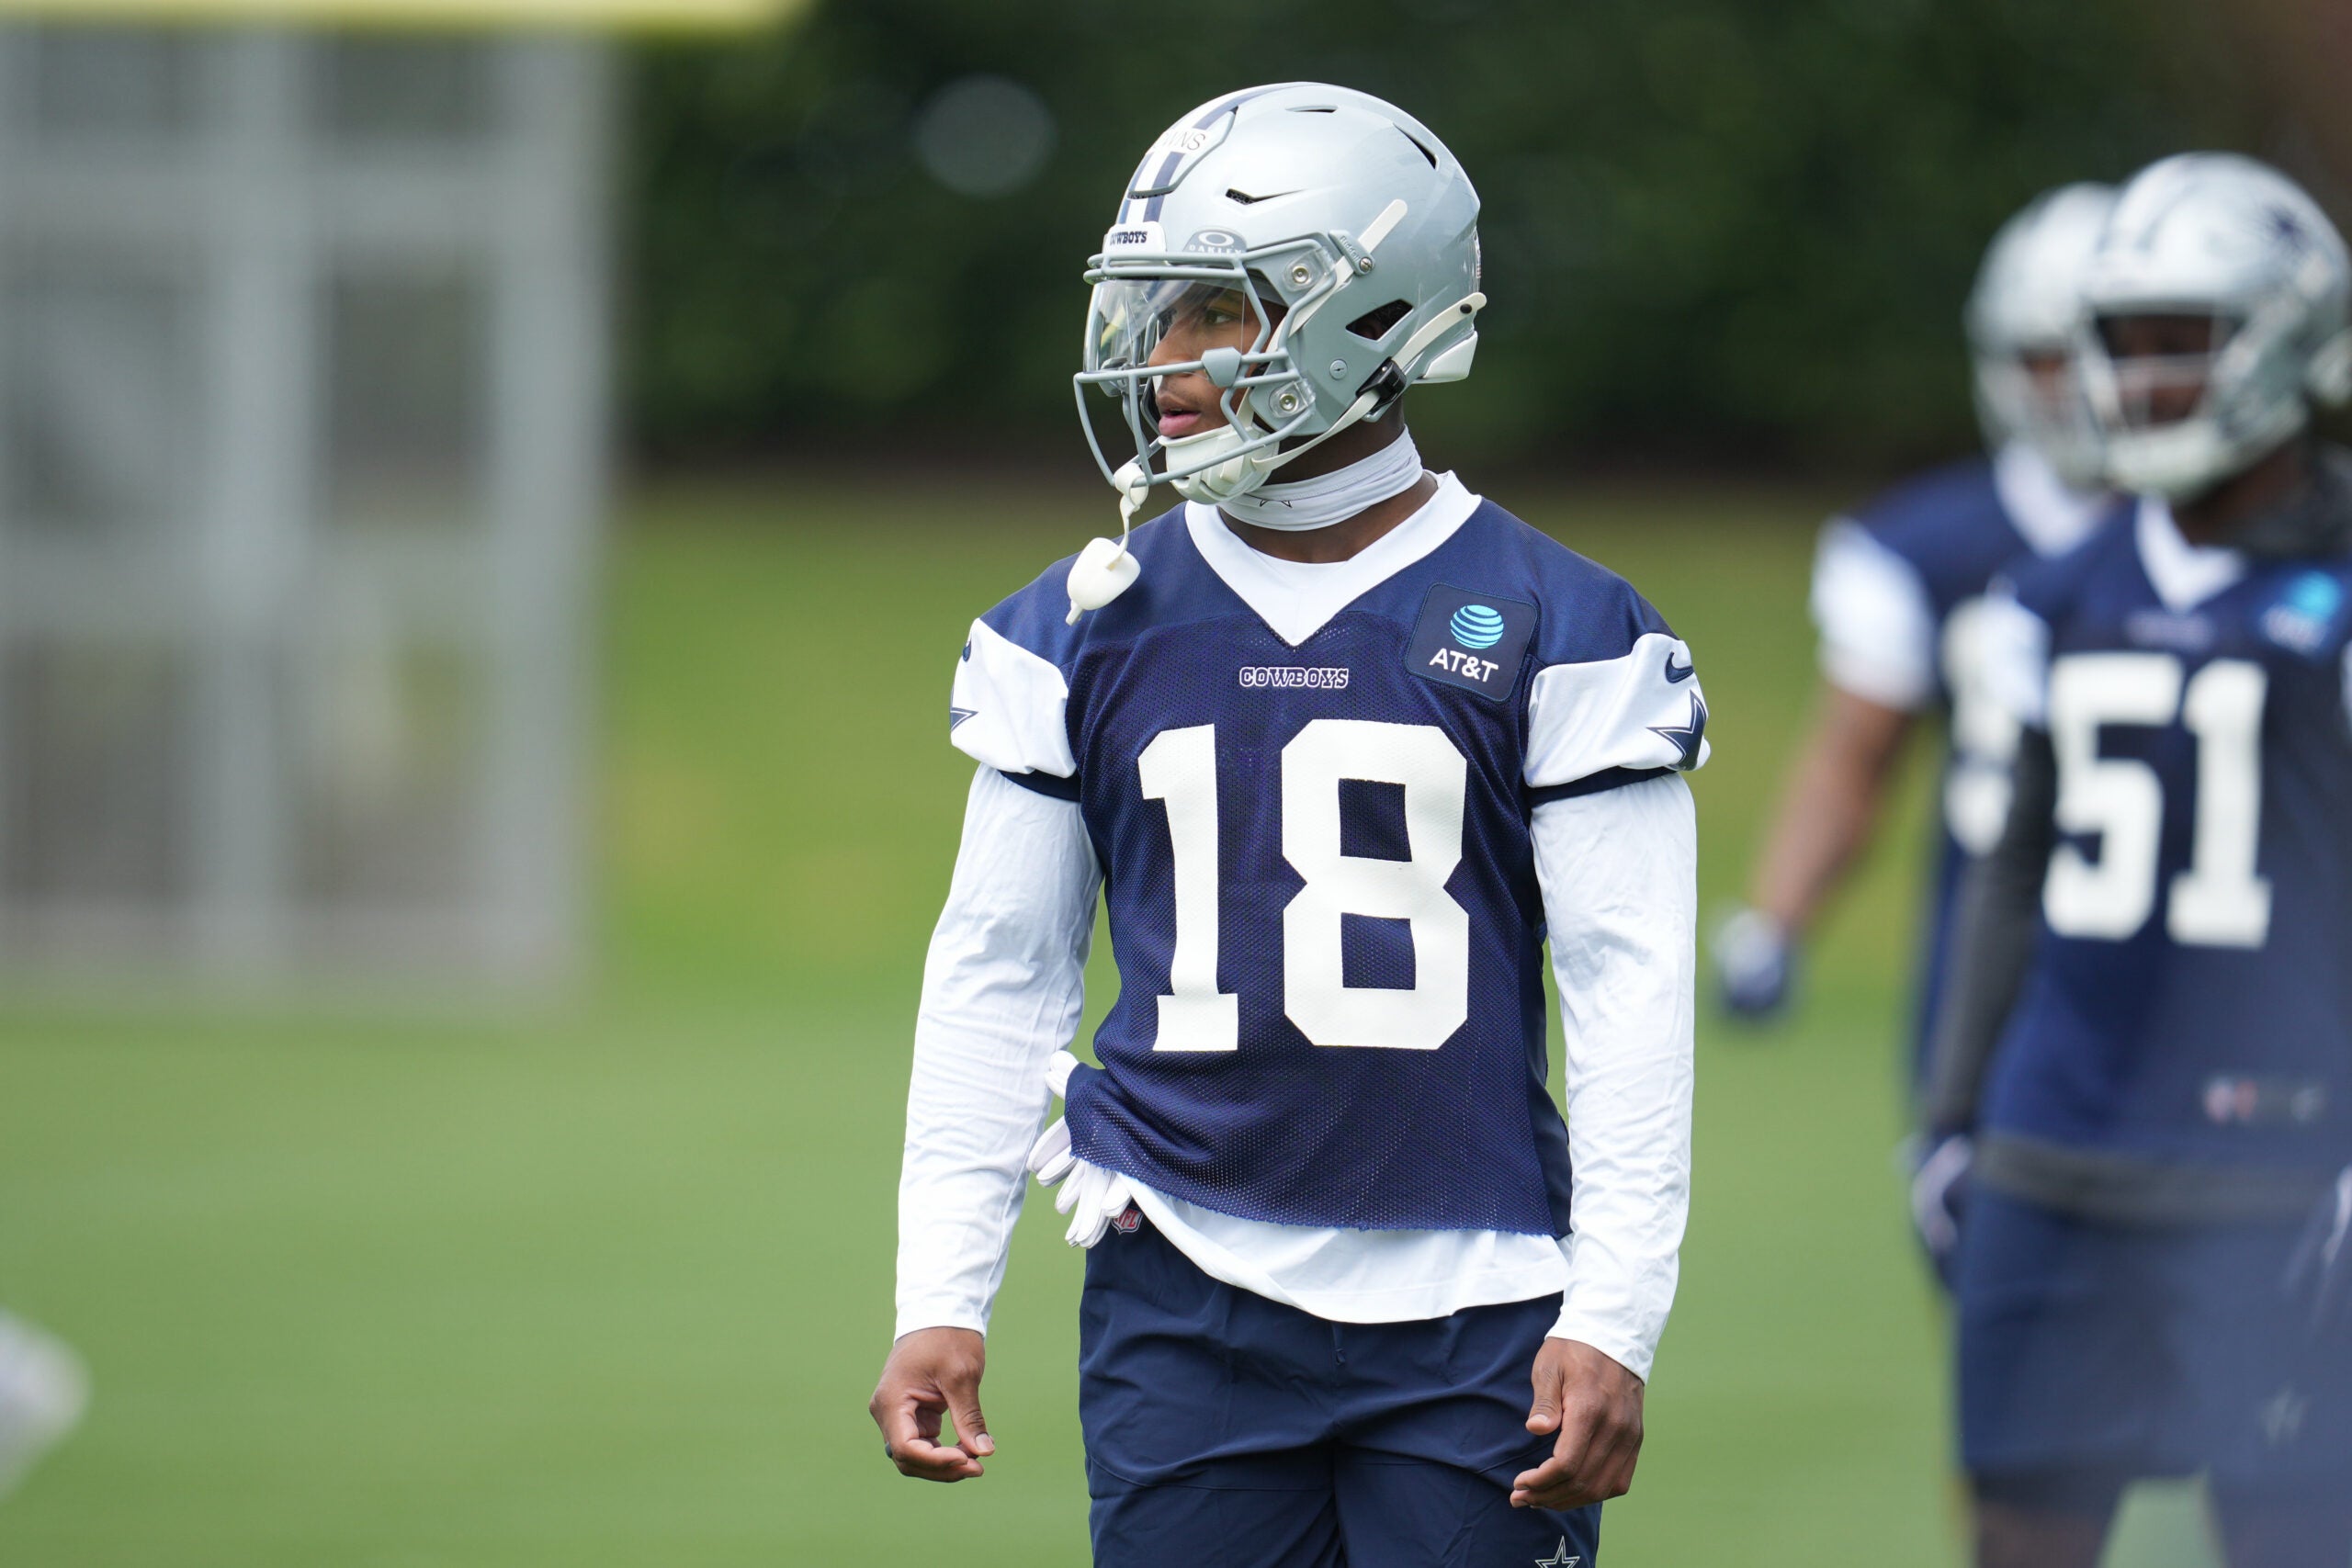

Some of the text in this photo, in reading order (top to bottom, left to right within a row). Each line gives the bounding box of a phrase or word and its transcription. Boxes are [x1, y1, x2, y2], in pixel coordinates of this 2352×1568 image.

[1239, 667, 1349, 688] COWBOYS
[1429, 648, 1499, 682] AT&T
[2042, 651, 2272, 950] 51
[1137, 719, 1469, 1051] 18
